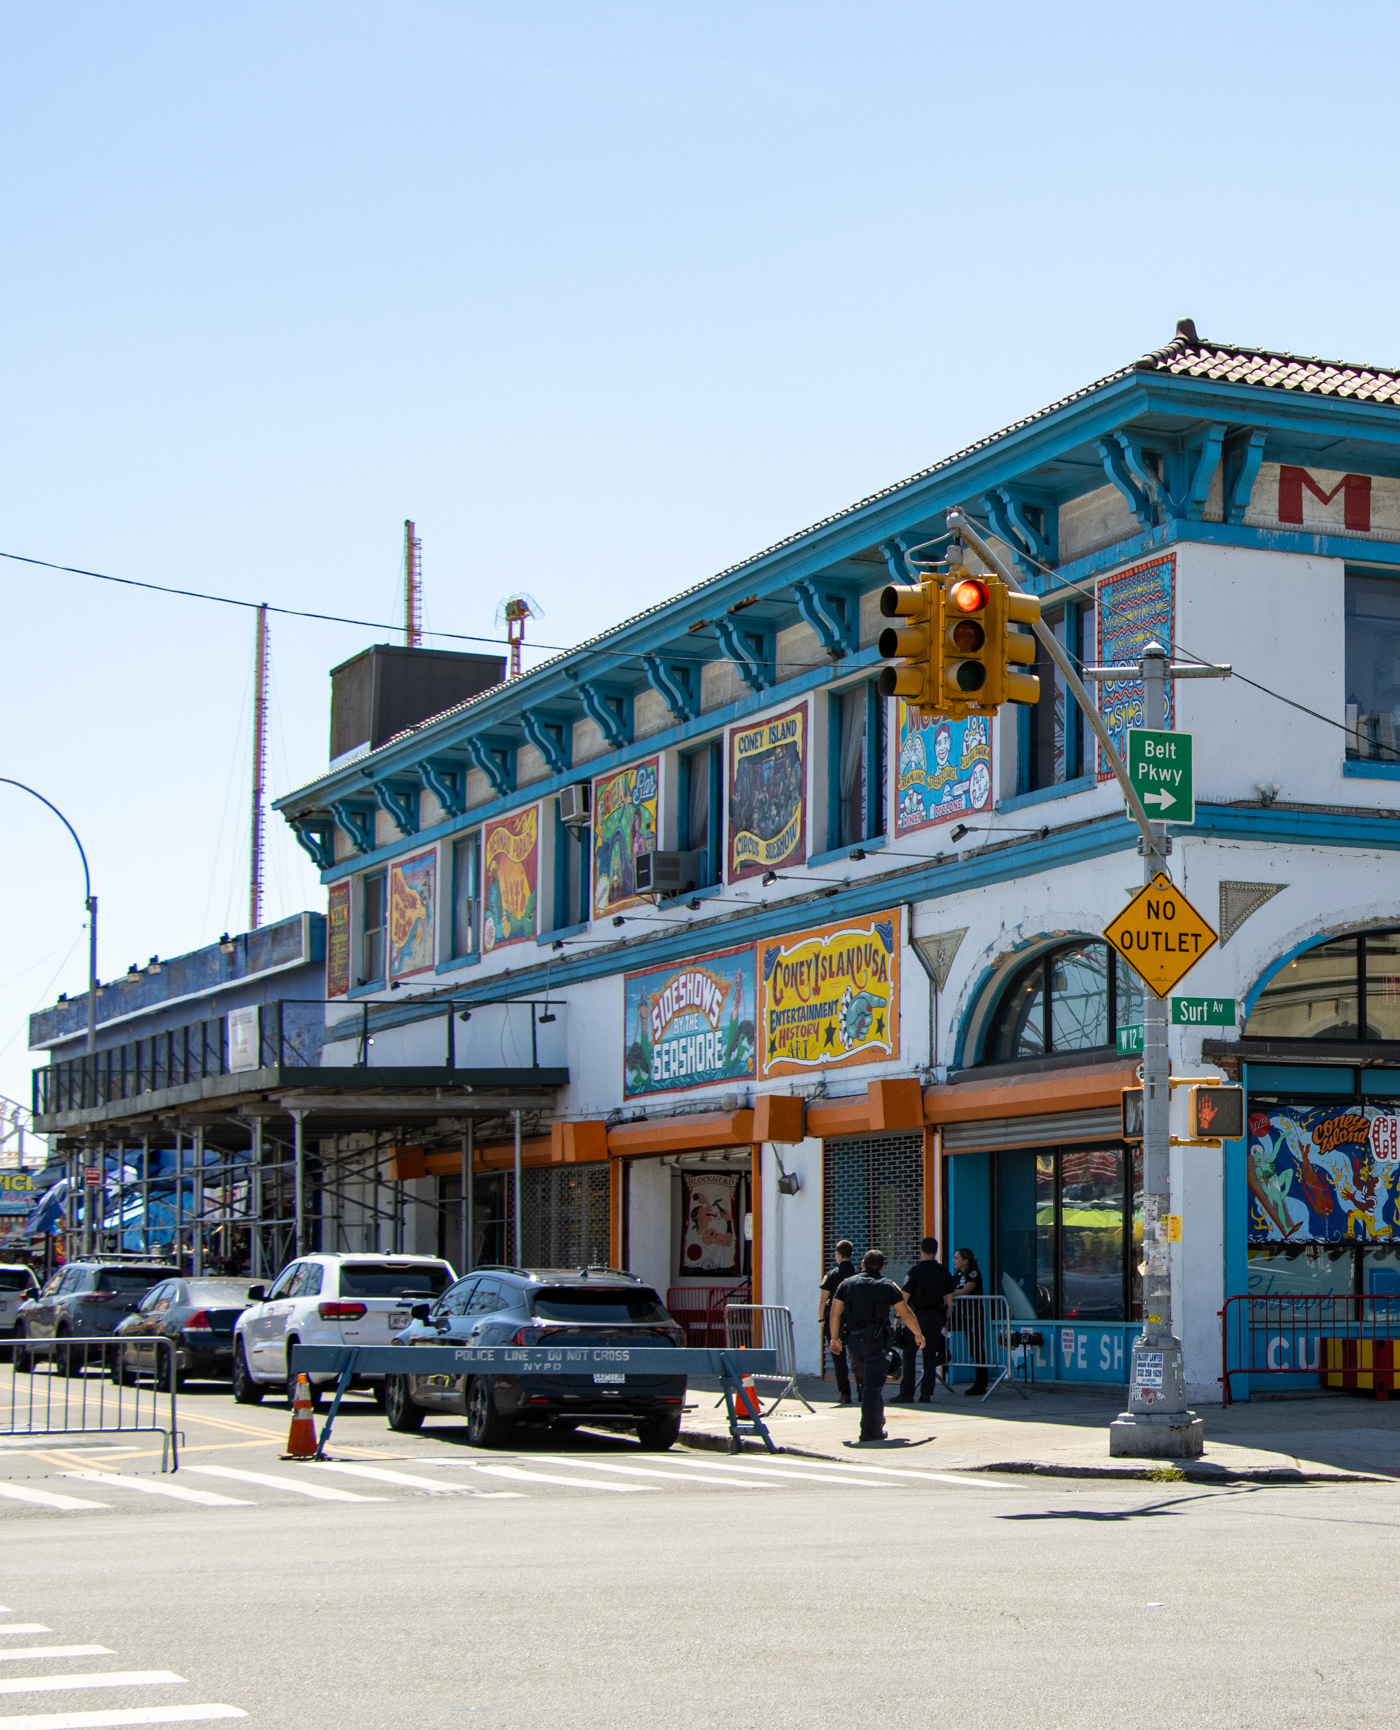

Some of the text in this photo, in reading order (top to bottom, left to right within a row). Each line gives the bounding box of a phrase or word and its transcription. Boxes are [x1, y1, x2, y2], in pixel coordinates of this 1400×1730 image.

[1103, 596, 1170, 633] MOST UNIQUE
[1113, 633, 1139, 653] SPOT
[738, 719, 797, 754] CONEY ISLAND
[1145, 740, 1176, 759] Belt
[1139, 762, 1183, 786] Pkwy
[934, 798, 962, 818] CYCLONE
[735, 821, 797, 860] CIRCUS SIDESHOW
[1147, 900, 1175, 920] NO
[1120, 930, 1202, 953] OUTLET
[772, 958, 812, 1006] CONEY
[651, 972, 723, 1043] SIDESHOWS
[769, 999, 840, 1035] ENTERTAINMENT
[1180, 1001, 1223, 1022] Surf Av
[674, 1012, 699, 1036] BY THE
[778, 1021, 820, 1048] HISTORY
[787, 1039, 809, 1059] ART
[1121, 1031, 1127, 1050] W
[1129, 1029, 1137, 1049] 12
[653, 1030, 723, 1081] SEASHORE
[688, 1175, 735, 1186] BLOCKHEAD
[454, 1350, 495, 1361] POLICE
[504, 1350, 529, 1361] LINE
[549, 1350, 562, 1361] DO
[566, 1350, 589, 1361] NOT
[593, 1350, 630, 1361] CROSS
[523, 1363, 562, 1371] NYPD
